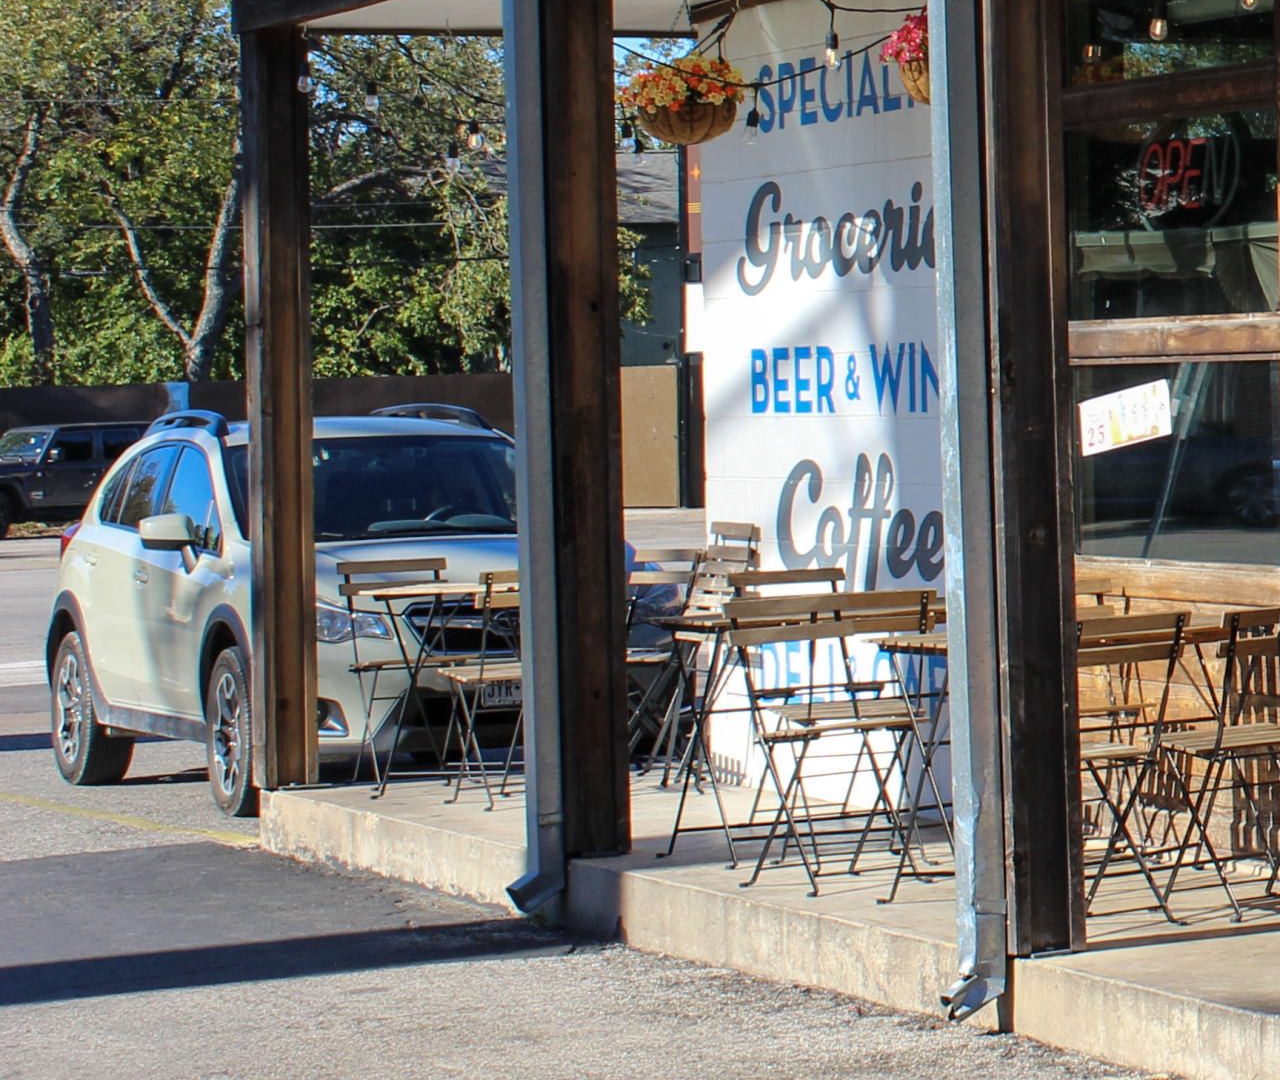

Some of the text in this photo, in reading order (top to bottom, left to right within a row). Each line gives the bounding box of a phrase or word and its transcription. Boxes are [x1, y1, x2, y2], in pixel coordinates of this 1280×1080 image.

[1140, 137, 1231, 209] OPEN
[751, 340, 941, 417] BEER & WIN
[776, 452, 945, 593] Coffee
